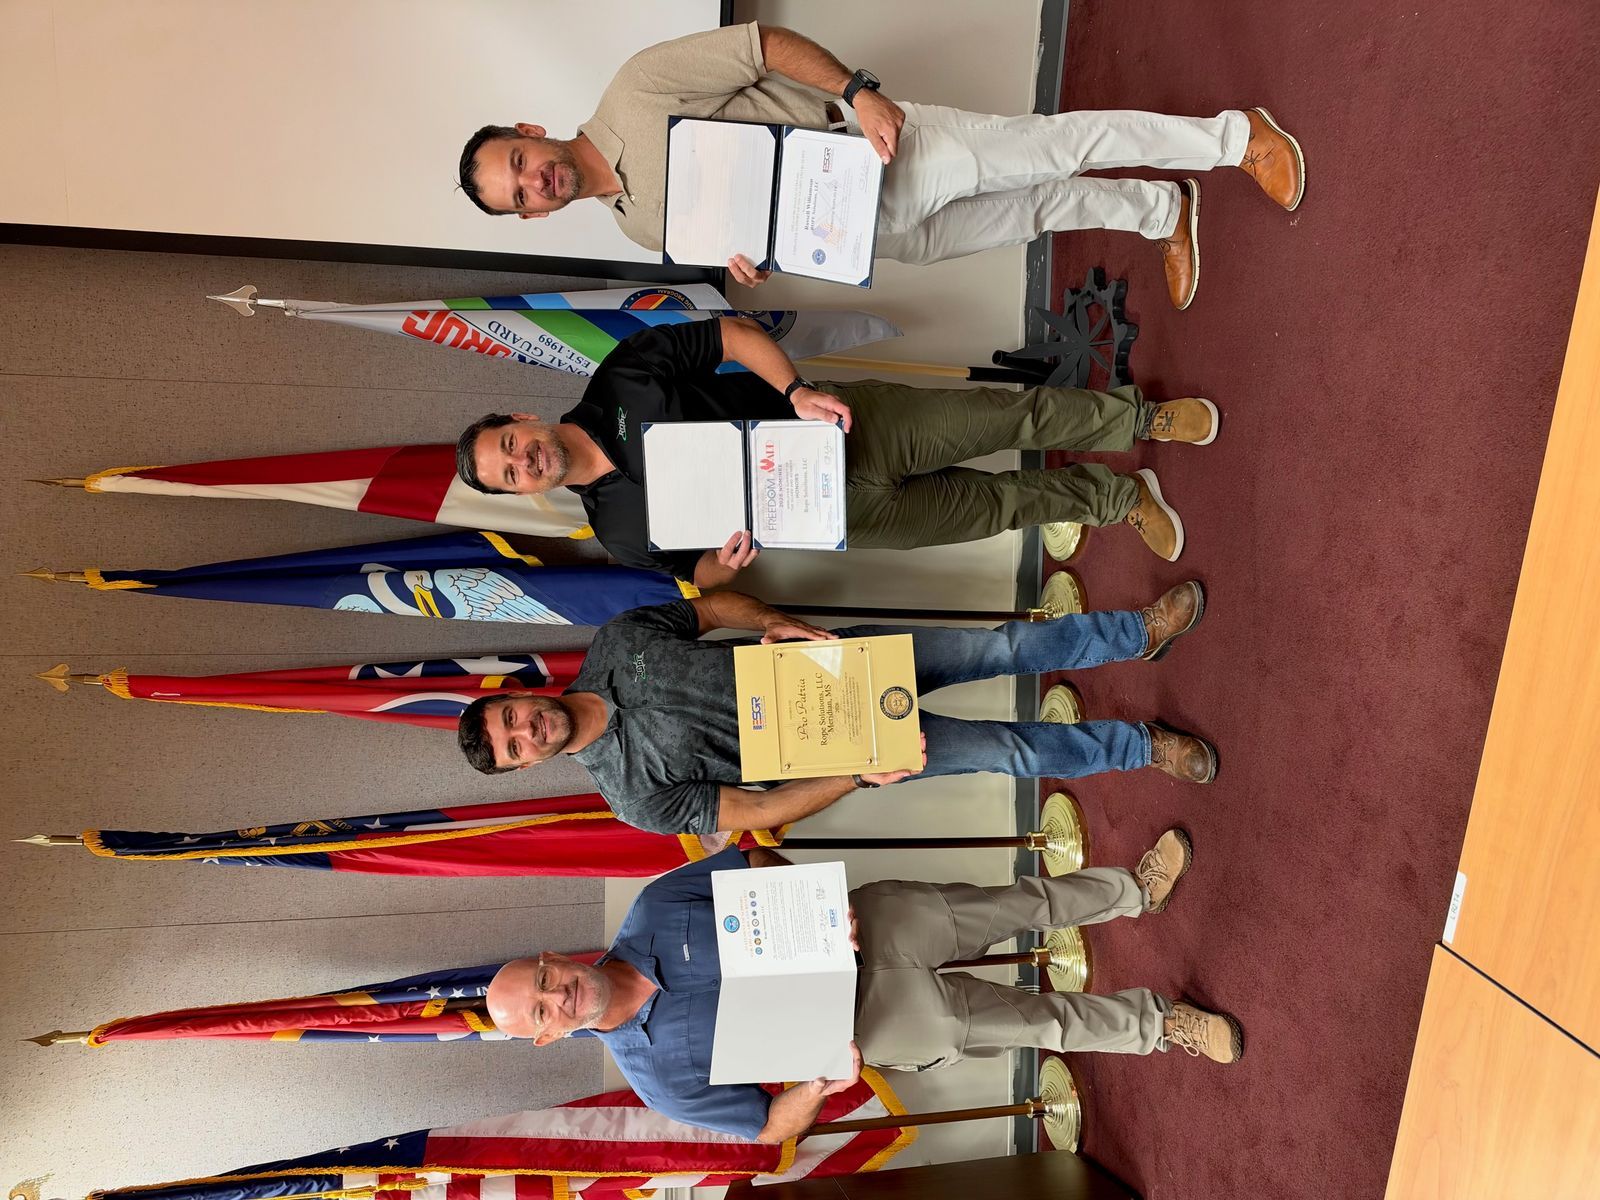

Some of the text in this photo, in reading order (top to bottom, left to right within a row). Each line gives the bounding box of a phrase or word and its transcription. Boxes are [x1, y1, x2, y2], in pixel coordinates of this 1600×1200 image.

[822, 147, 831, 173] ESGR
[487, 320, 544, 357] GUARD
[538, 334, 564, 353] 1989
[767, 478, 777, 531] FREEDOM
[824, 684, 832, 697] MS
[751, 696, 762, 730] ESGR
[795, 678, 809, 740] Pro Patria
[815, 672, 829, 745] Rope Solutions, LLC
